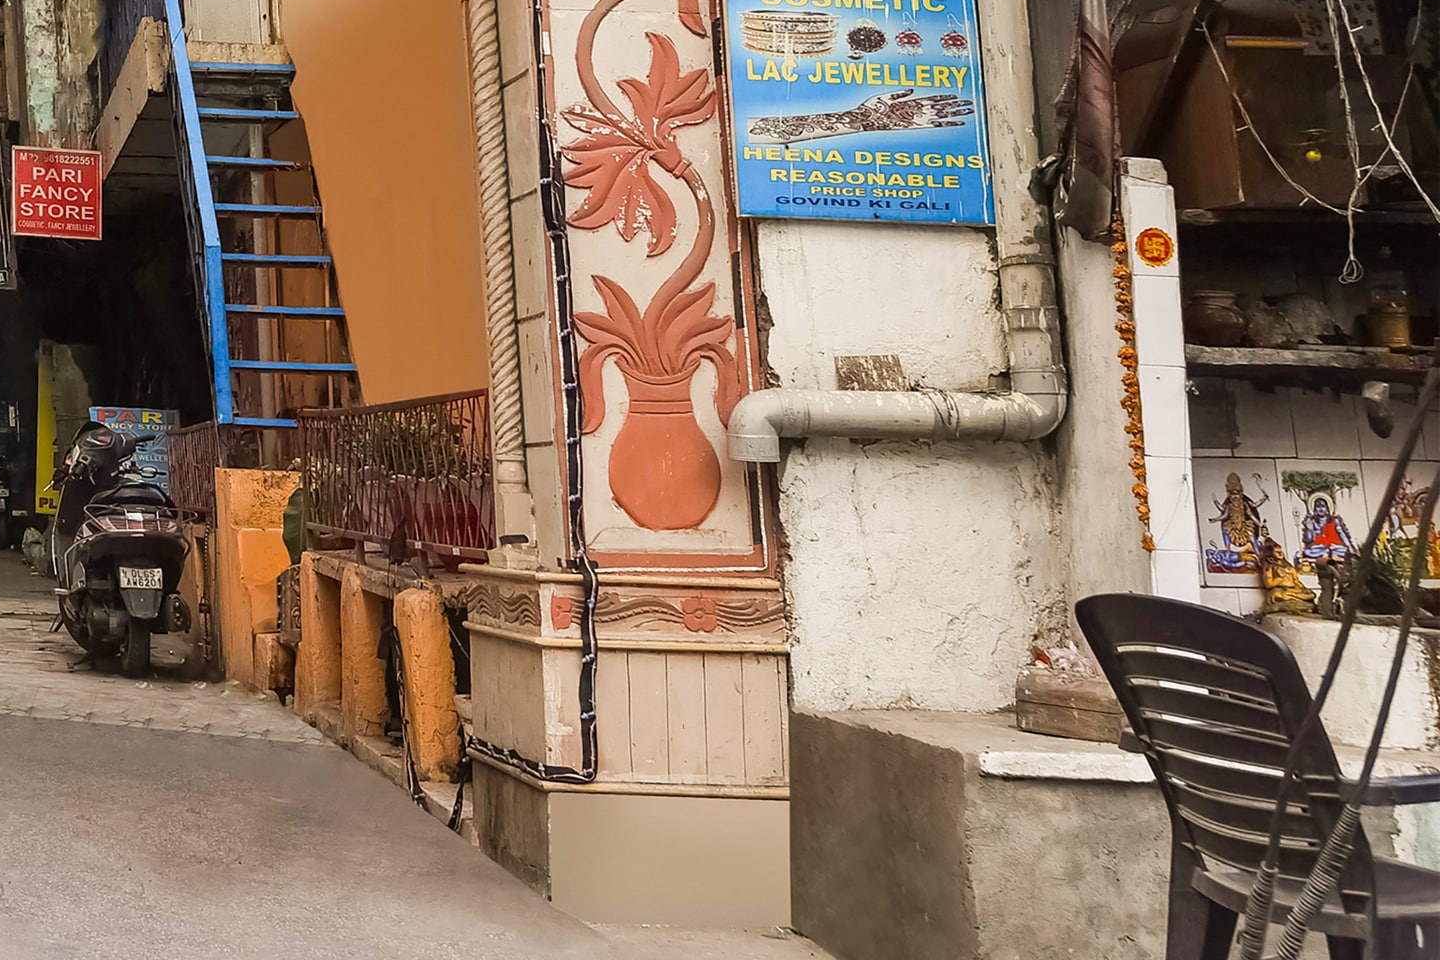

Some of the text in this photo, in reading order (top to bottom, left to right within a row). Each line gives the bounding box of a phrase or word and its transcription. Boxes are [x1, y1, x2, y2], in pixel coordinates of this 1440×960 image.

[746, 58, 968, 88] LAC JEWELLERY
[743, 146, 985, 169] HEENA DESIGNS
[32, 167, 81, 183] PARI
[770, 168, 961, 189] REASONABLE
[20, 184, 93, 202] FANCY
[810, 186, 923, 199] PRICE SHOP
[20, 202, 95, 220] STORE
[775, 196, 951, 211] GOVIND KI GALI
[104, 422, 134, 430] ANCY
